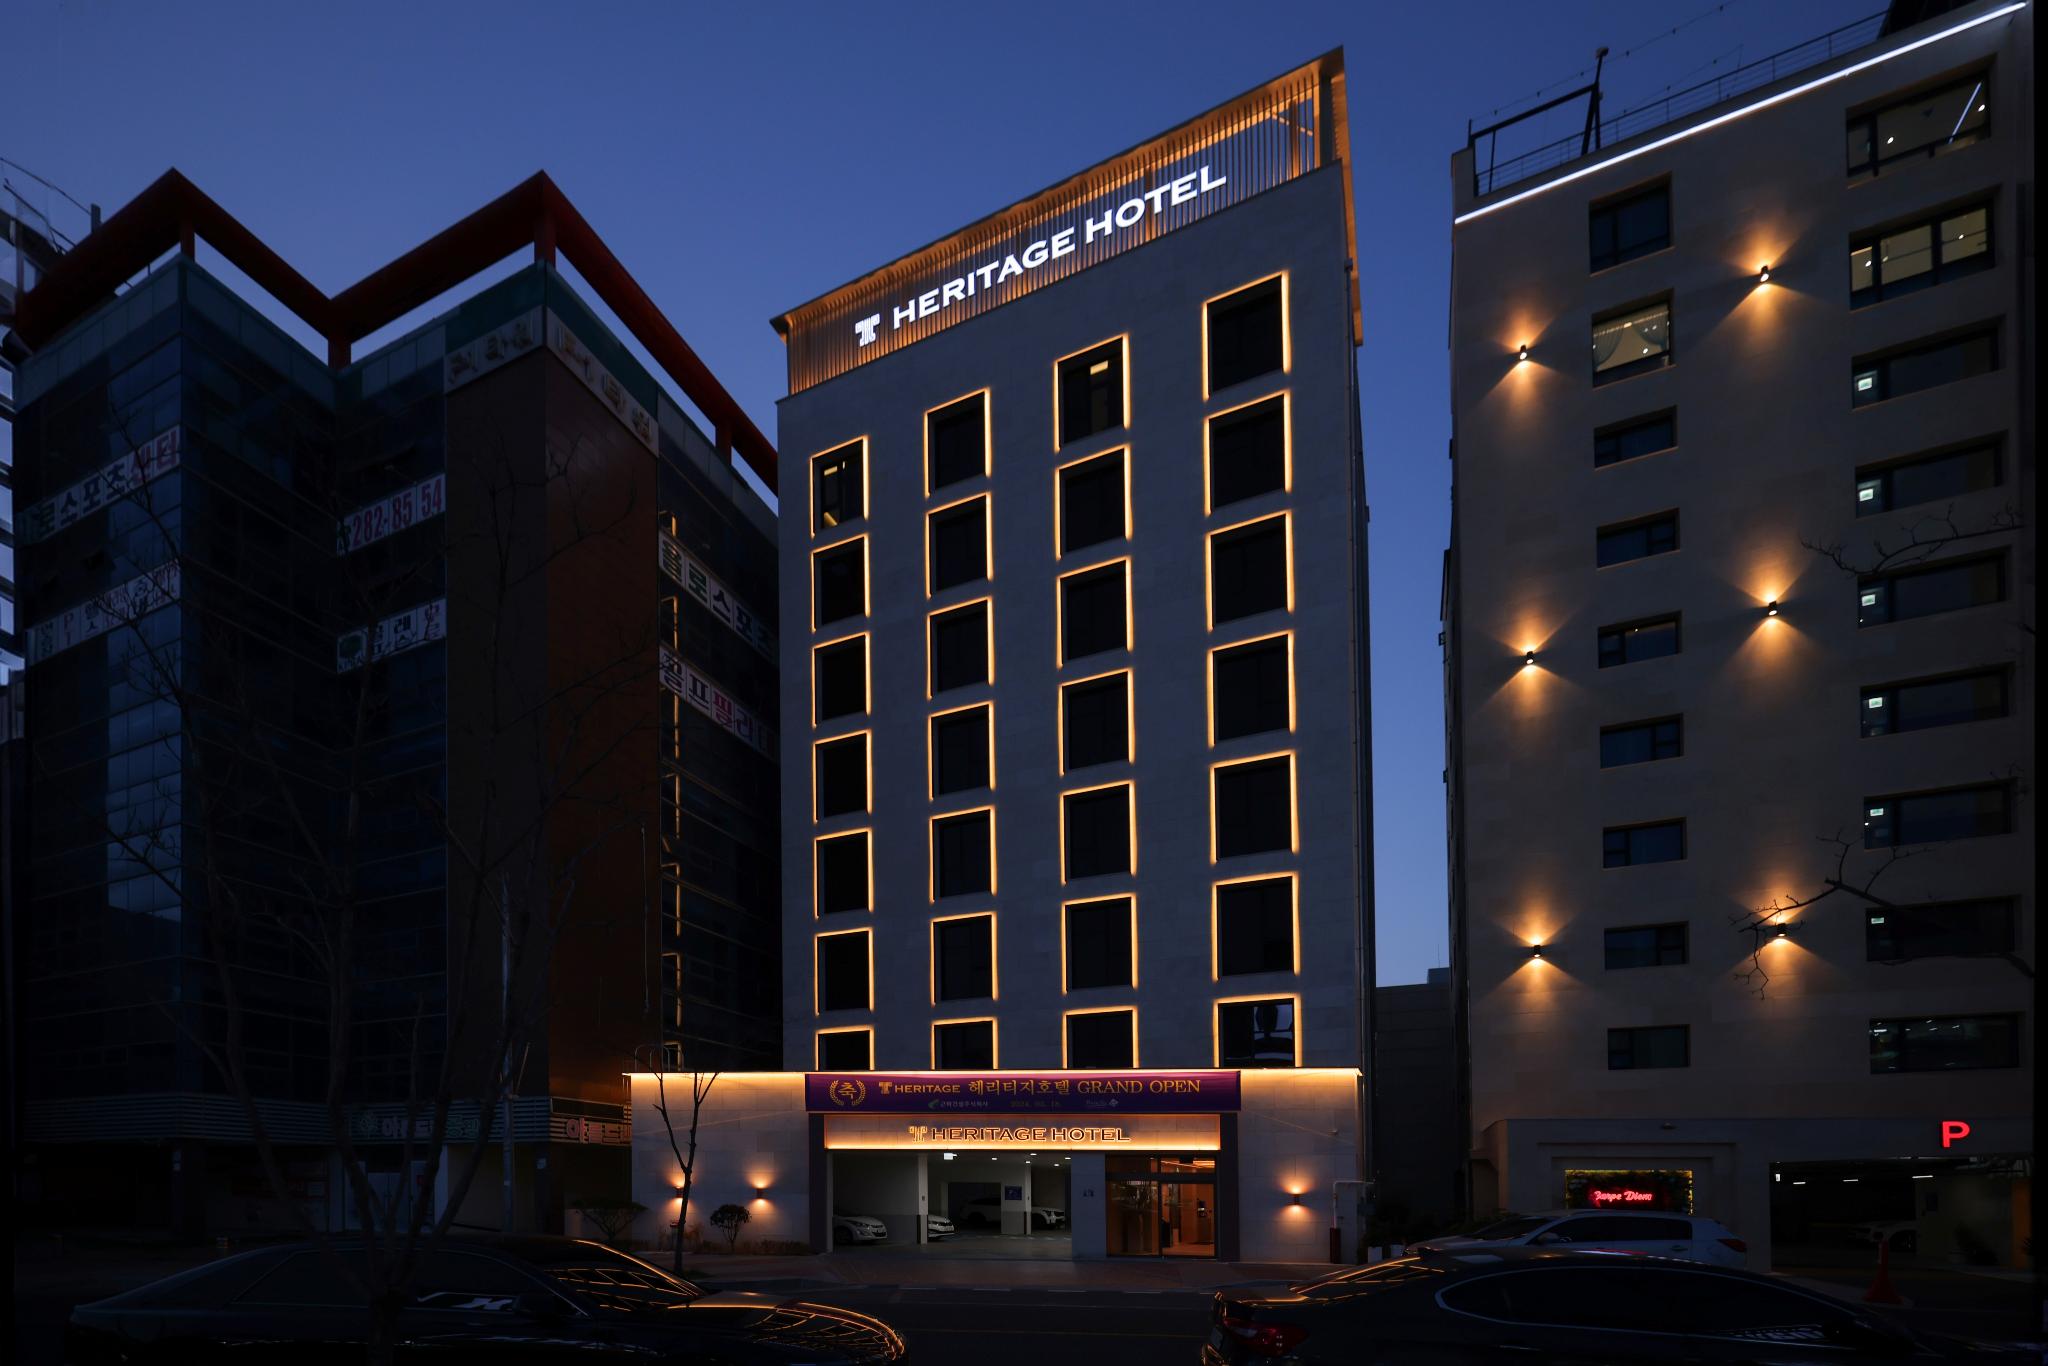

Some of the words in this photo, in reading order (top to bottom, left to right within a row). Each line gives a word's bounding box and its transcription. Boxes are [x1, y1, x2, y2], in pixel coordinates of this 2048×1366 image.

[893, 226, 1076, 330] HERITAGE
[1085, 165, 1228, 244] HOTEL
[837, 1082, 856, 1098] 축
[894, 1084, 961, 1094] HERITAGE
[968, 1078, 1071, 1097] 헤리티지호텔
[1077, 1080, 1144, 1095] GRAND
[1149, 1079, 1202, 1095] OPEN
[931, 1127, 1047, 1142] HERITAGE
[1051, 1127, 1132, 1142] HOTEL
[1940, 1120, 1971, 1148] P
